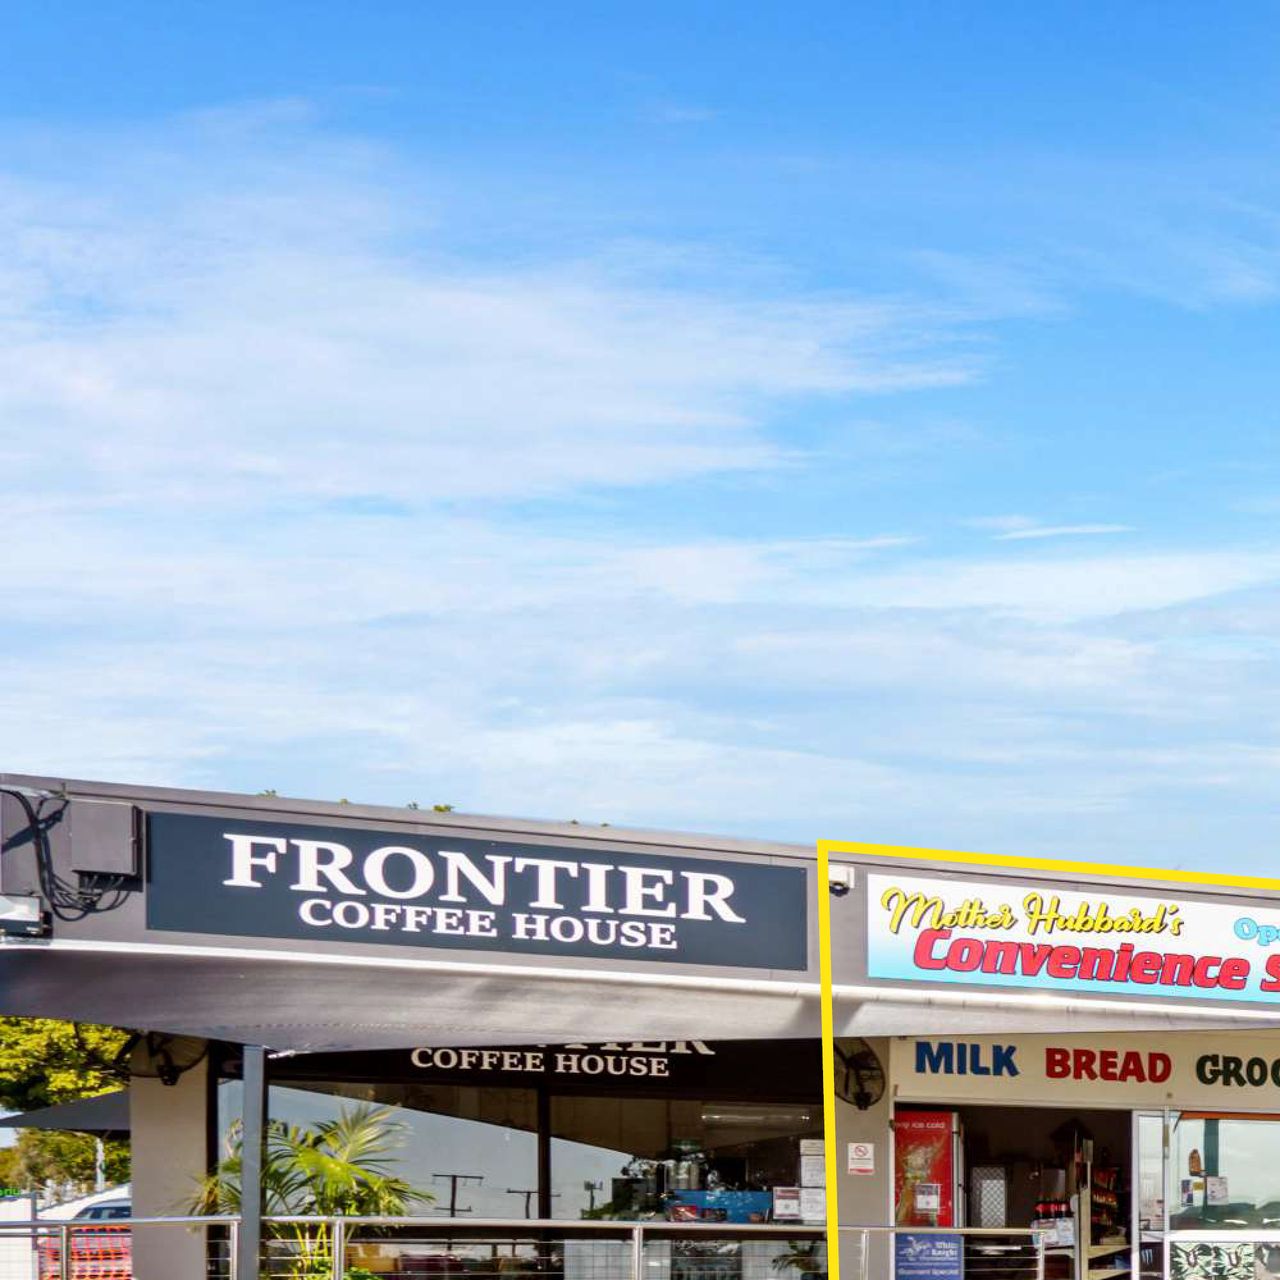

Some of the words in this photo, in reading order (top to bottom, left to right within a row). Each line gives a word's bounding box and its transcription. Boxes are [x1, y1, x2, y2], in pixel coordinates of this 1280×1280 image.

[222, 833, 746, 924] FRONTIER
[300, 899, 498, 937] COFFEE
[512, 914, 677, 949] HOUSE
[880, 887, 1018, 934] Mother
[1022, 892, 1184, 936] Hubbard's
[913, 927, 1249, 990] Convenience
[411, 1047, 545, 1072] COFFEE
[555, 1053, 669, 1076] HOUSE
[914, 1041, 1021, 1078] MILK
[1045, 1047, 1172, 1084] BREAD
